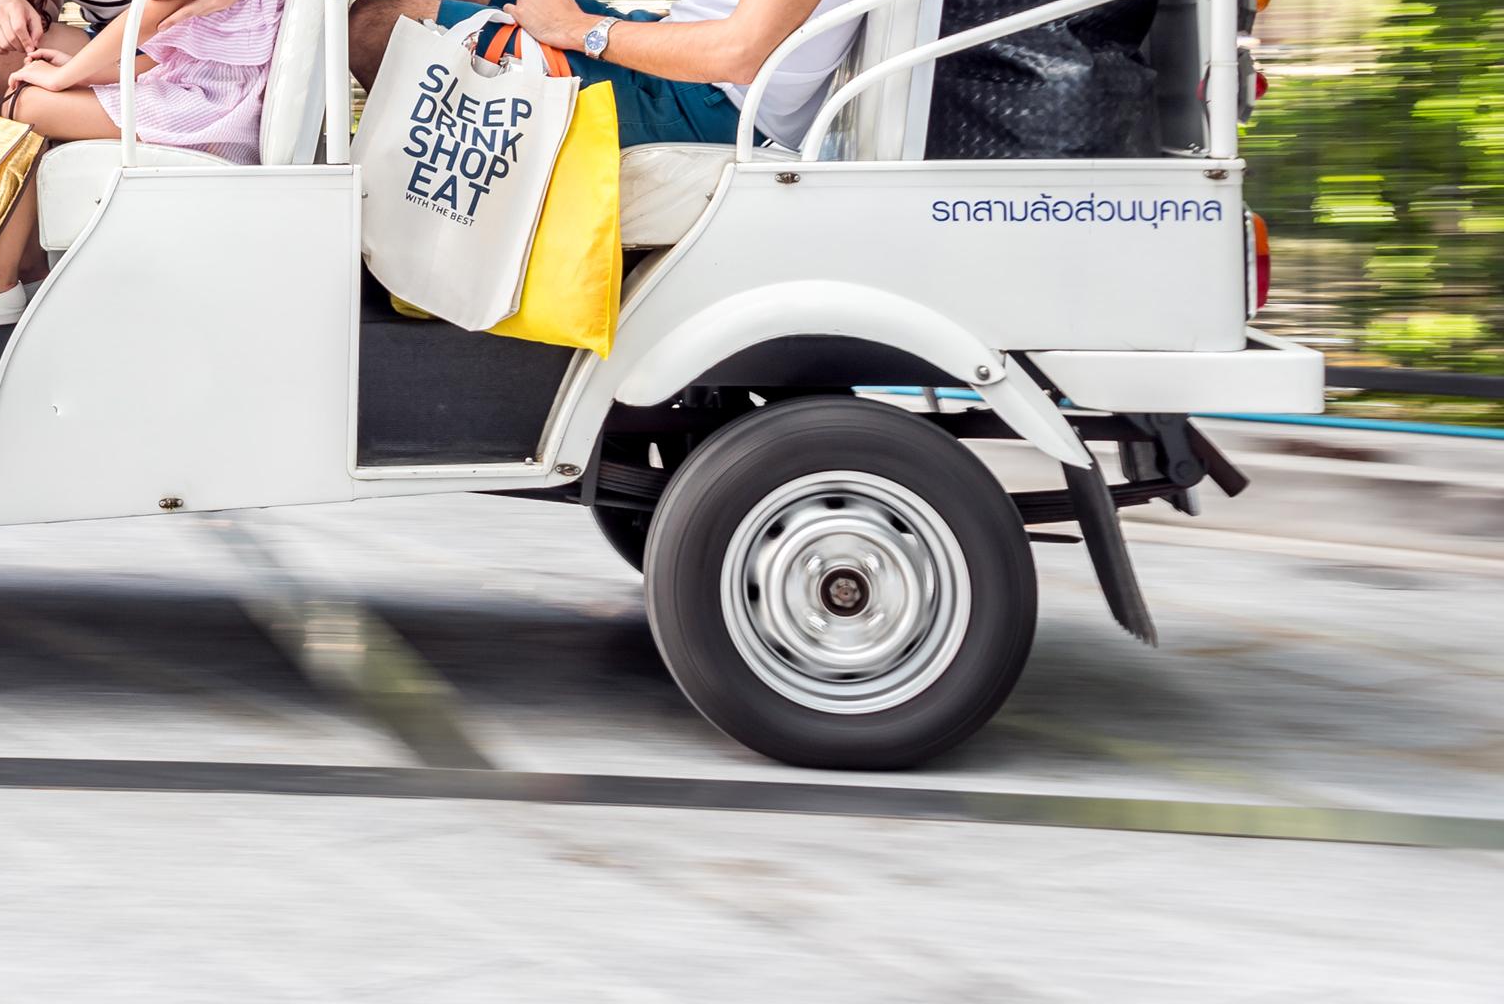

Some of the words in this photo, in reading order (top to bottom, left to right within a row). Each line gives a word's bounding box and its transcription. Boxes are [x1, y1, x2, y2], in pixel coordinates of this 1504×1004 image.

[418, 64, 533, 128] SLEEP
[402, 125, 510, 187] SHOP
[410, 93, 524, 163] DRINK
[405, 192, 430, 209] WITH
[431, 203, 448, 217] THE
[450, 212, 475, 227] BEST
[407, 160, 491, 217] EAT
[931, 192, 1223, 230] รถสามล้อส่วนบุคคล
